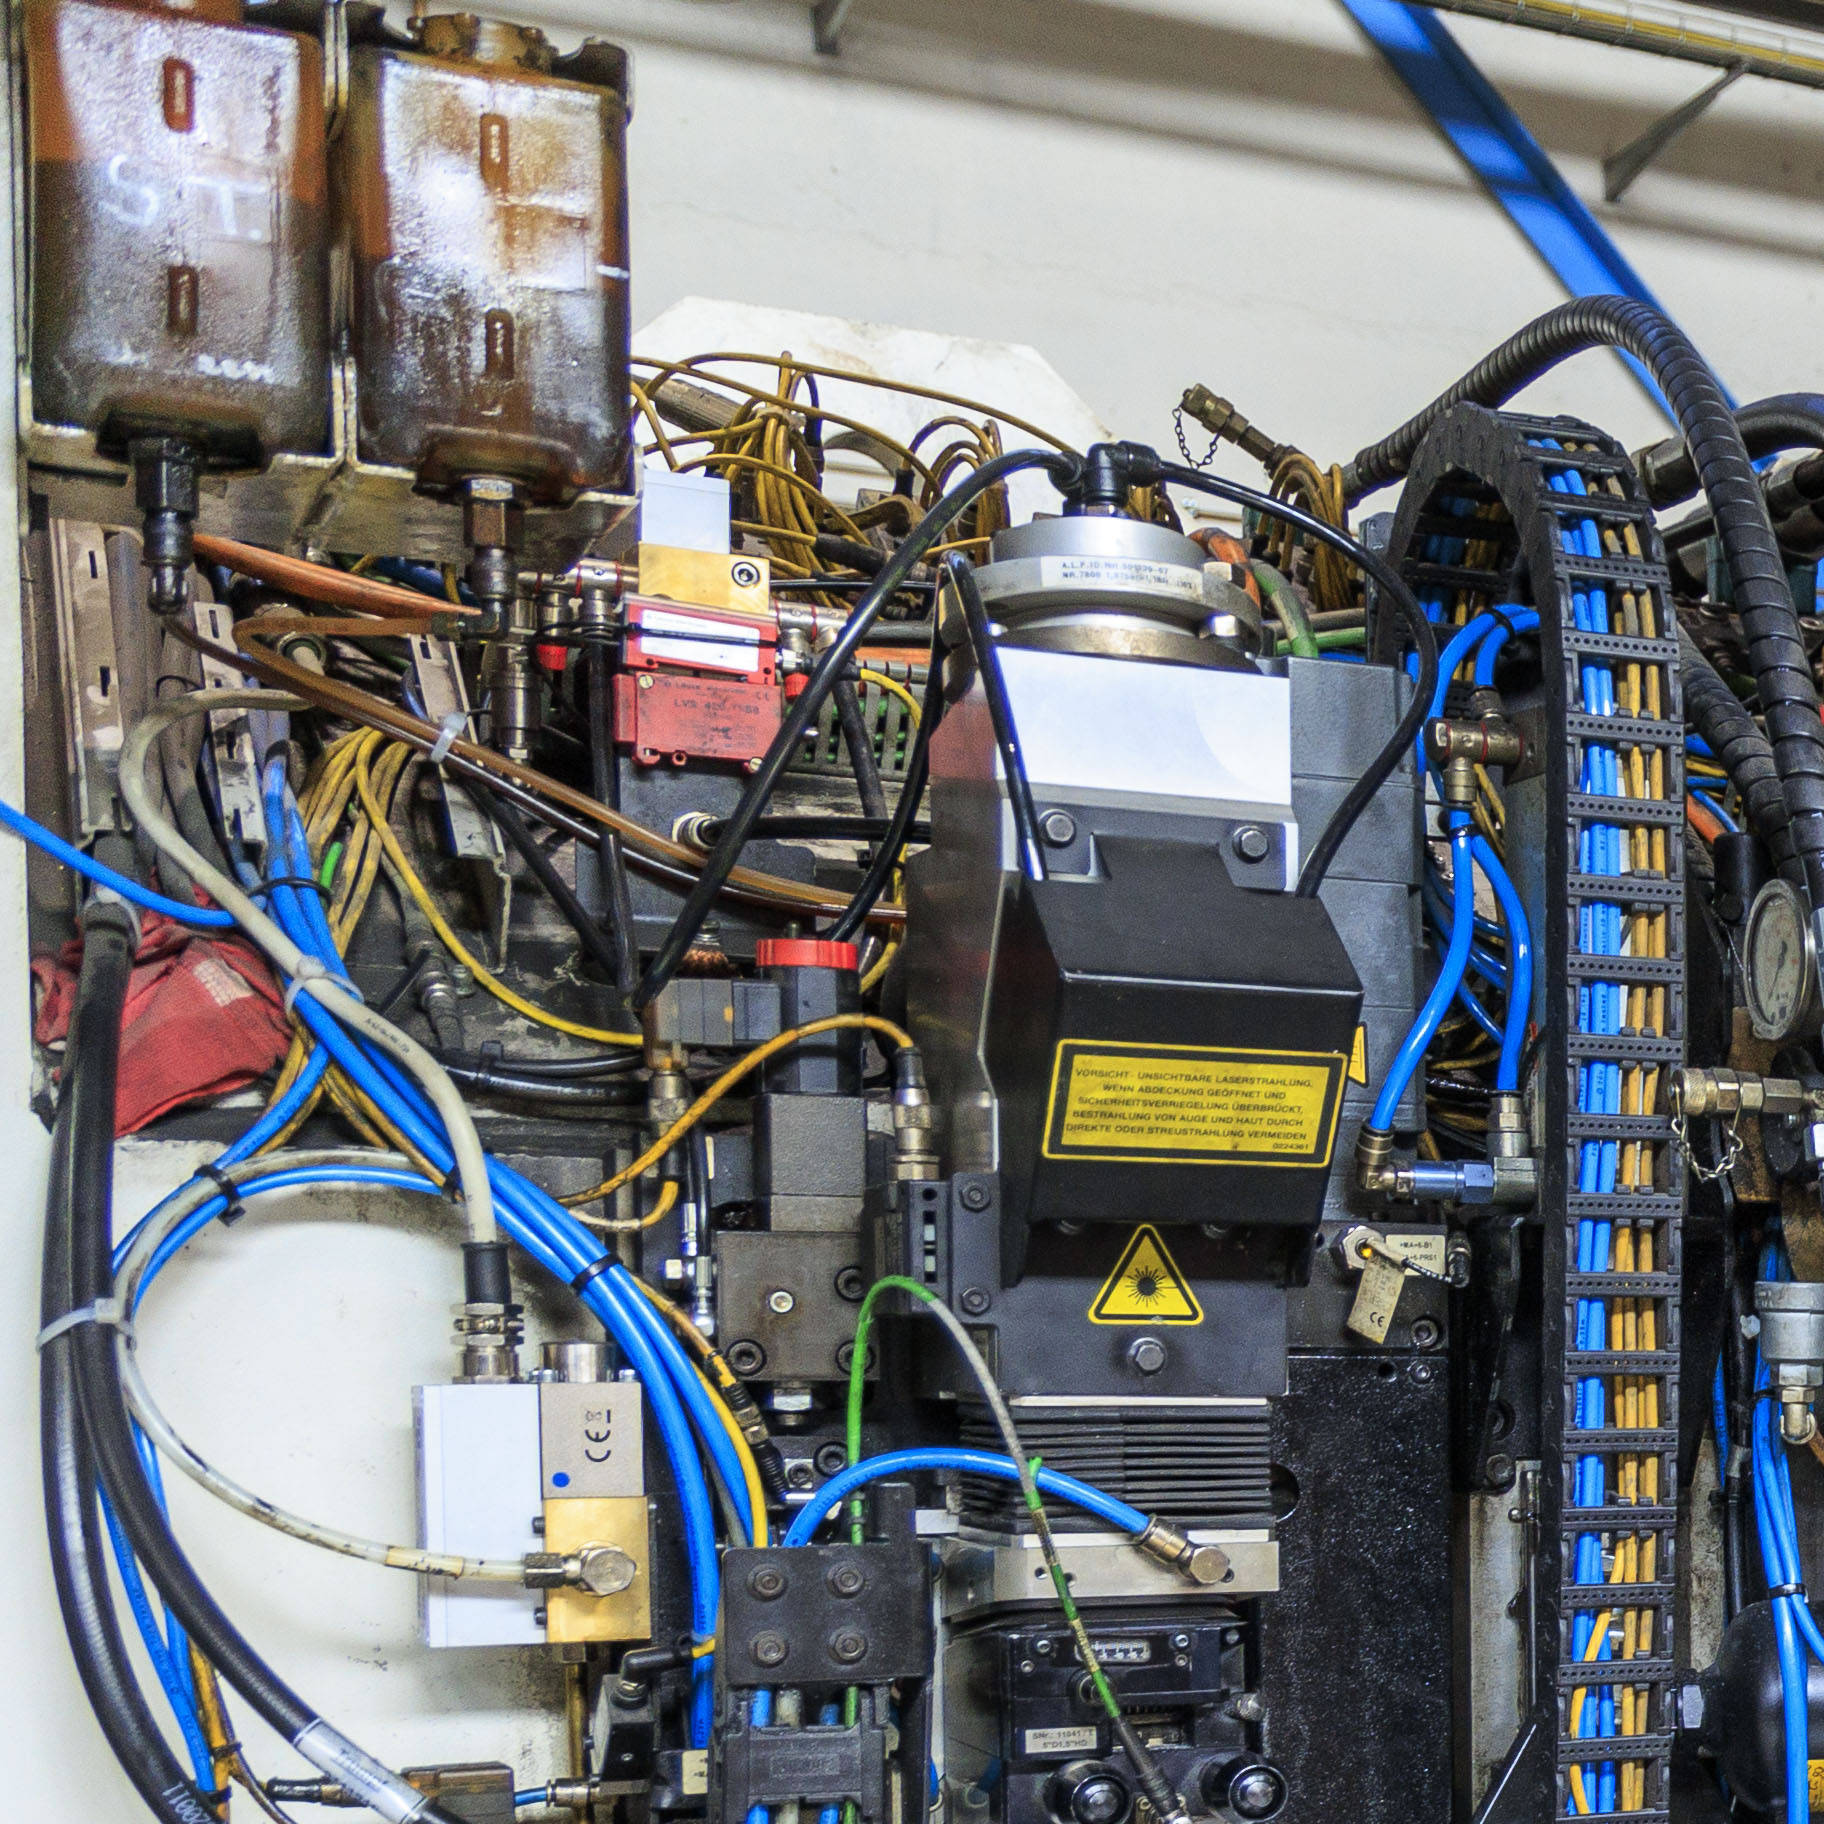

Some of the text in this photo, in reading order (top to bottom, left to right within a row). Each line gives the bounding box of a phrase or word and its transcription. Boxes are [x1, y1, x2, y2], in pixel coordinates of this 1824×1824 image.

[1076, 1068, 1130, 1079] VORSICHT
[1137, 1072, 1213, 1084] UNSICHTBARE
[1102, 1083, 1287, 1100] WENN ABDECKUNG GEÖFFNET UND
[1077, 1096, 1228, 1112] SICHERHEITSVERRIEGELUNG
[1072, 1111, 1304, 1126] BESTRAHLUNG VON AUGE UND HAUT DURCH
[1066, 1123, 1307, 1140] DIREKTE ODER STREUSTRAHLUNG VERMEIDEN
